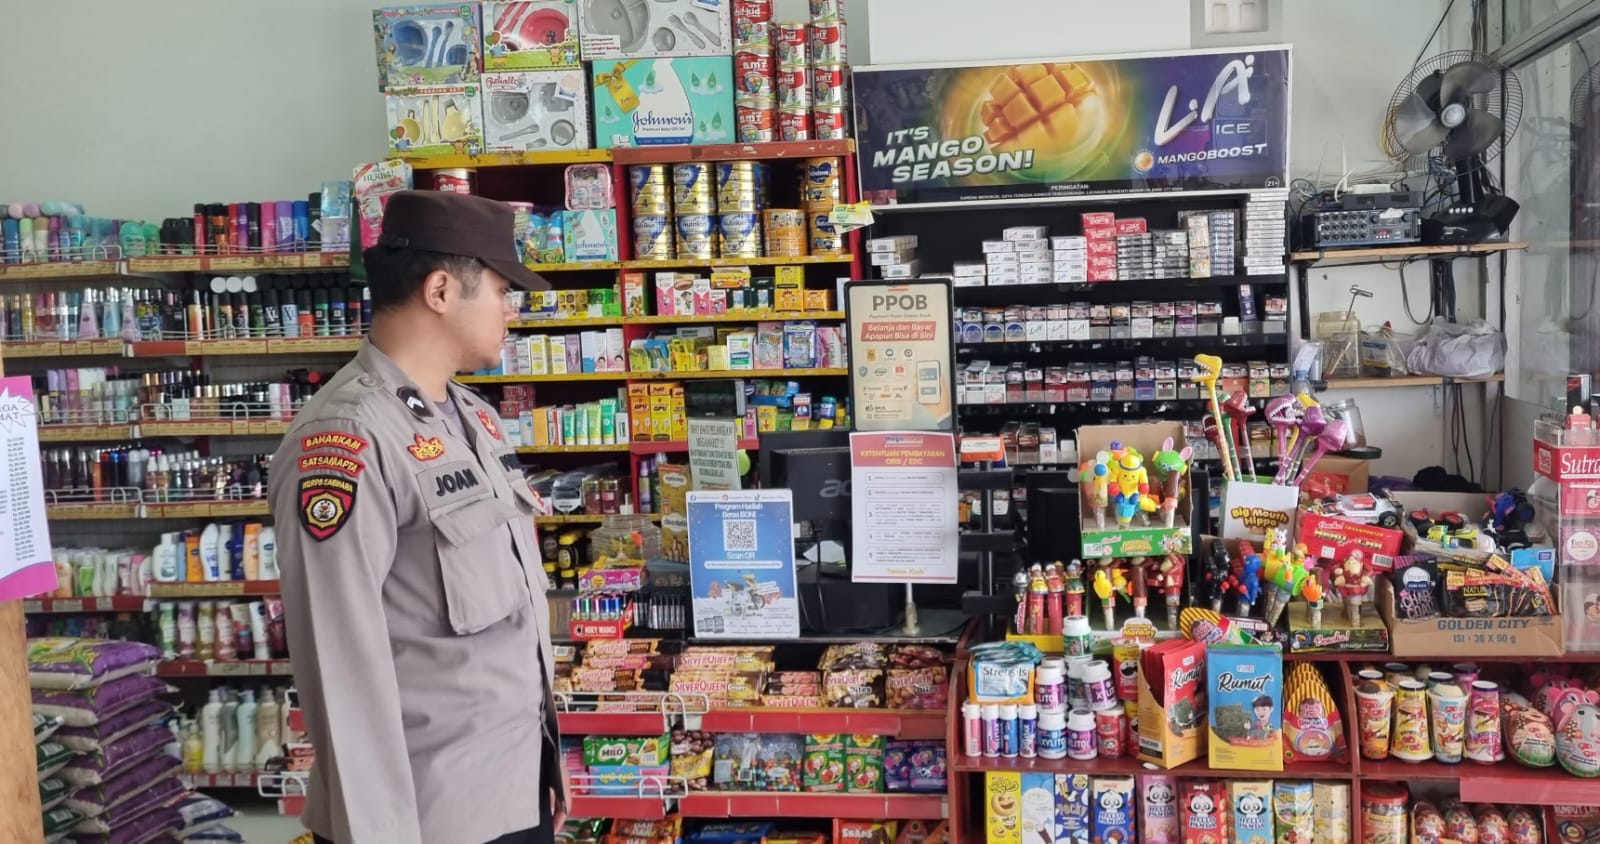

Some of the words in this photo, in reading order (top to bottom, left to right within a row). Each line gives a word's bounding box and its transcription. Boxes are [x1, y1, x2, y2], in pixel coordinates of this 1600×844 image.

[632, 110, 692, 133] Johnson's
[1216, 123, 1251, 134] ICE
[886, 126, 929, 145] IT'S
[873, 136, 984, 168] MANGO
[1157, 143, 1268, 165] MANGOBOOST
[891, 149, 1035, 183] SEASON!
[641, 199, 649, 207] 4
[691, 197, 698, 206] 4
[723, 196, 730, 205] 4
[872, 294, 928, 311] PPOB
[868, 323, 895, 332] Belanja
[896, 323, 910, 331] dan
[911, 323, 933, 332] Bayar
[864, 332, 893, 341] Apapun
[894, 331, 910, 339] Bisa
[911, 331, 918, 339] di
[919, 331, 934, 339] Sini
[306, 434, 361, 450] BAHARKAM
[302, 456, 358, 473] SATSAMAPTA
[435, 468, 479, 497] JOAN
[714, 503, 740, 511] Program
[1231, 507, 1250, 517] Big
[1252, 508, 1288, 522] Mouth
[1244, 516, 1278, 527] Hippo
[727, 552, 743, 560] Scan
[1437, 619, 1493, 631] GOLDEN
[1497, 619, 1530, 629] CITY
[1123, 629, 1155, 637] Monkey
[1497, 634, 1508, 642] 50
[675, 682, 728, 692] SILVERQUEEN
[1219, 671, 1272, 692] Rumut
[768, 698, 818, 706] SILVERQUEEN
[601, 748, 624, 757] MILO
